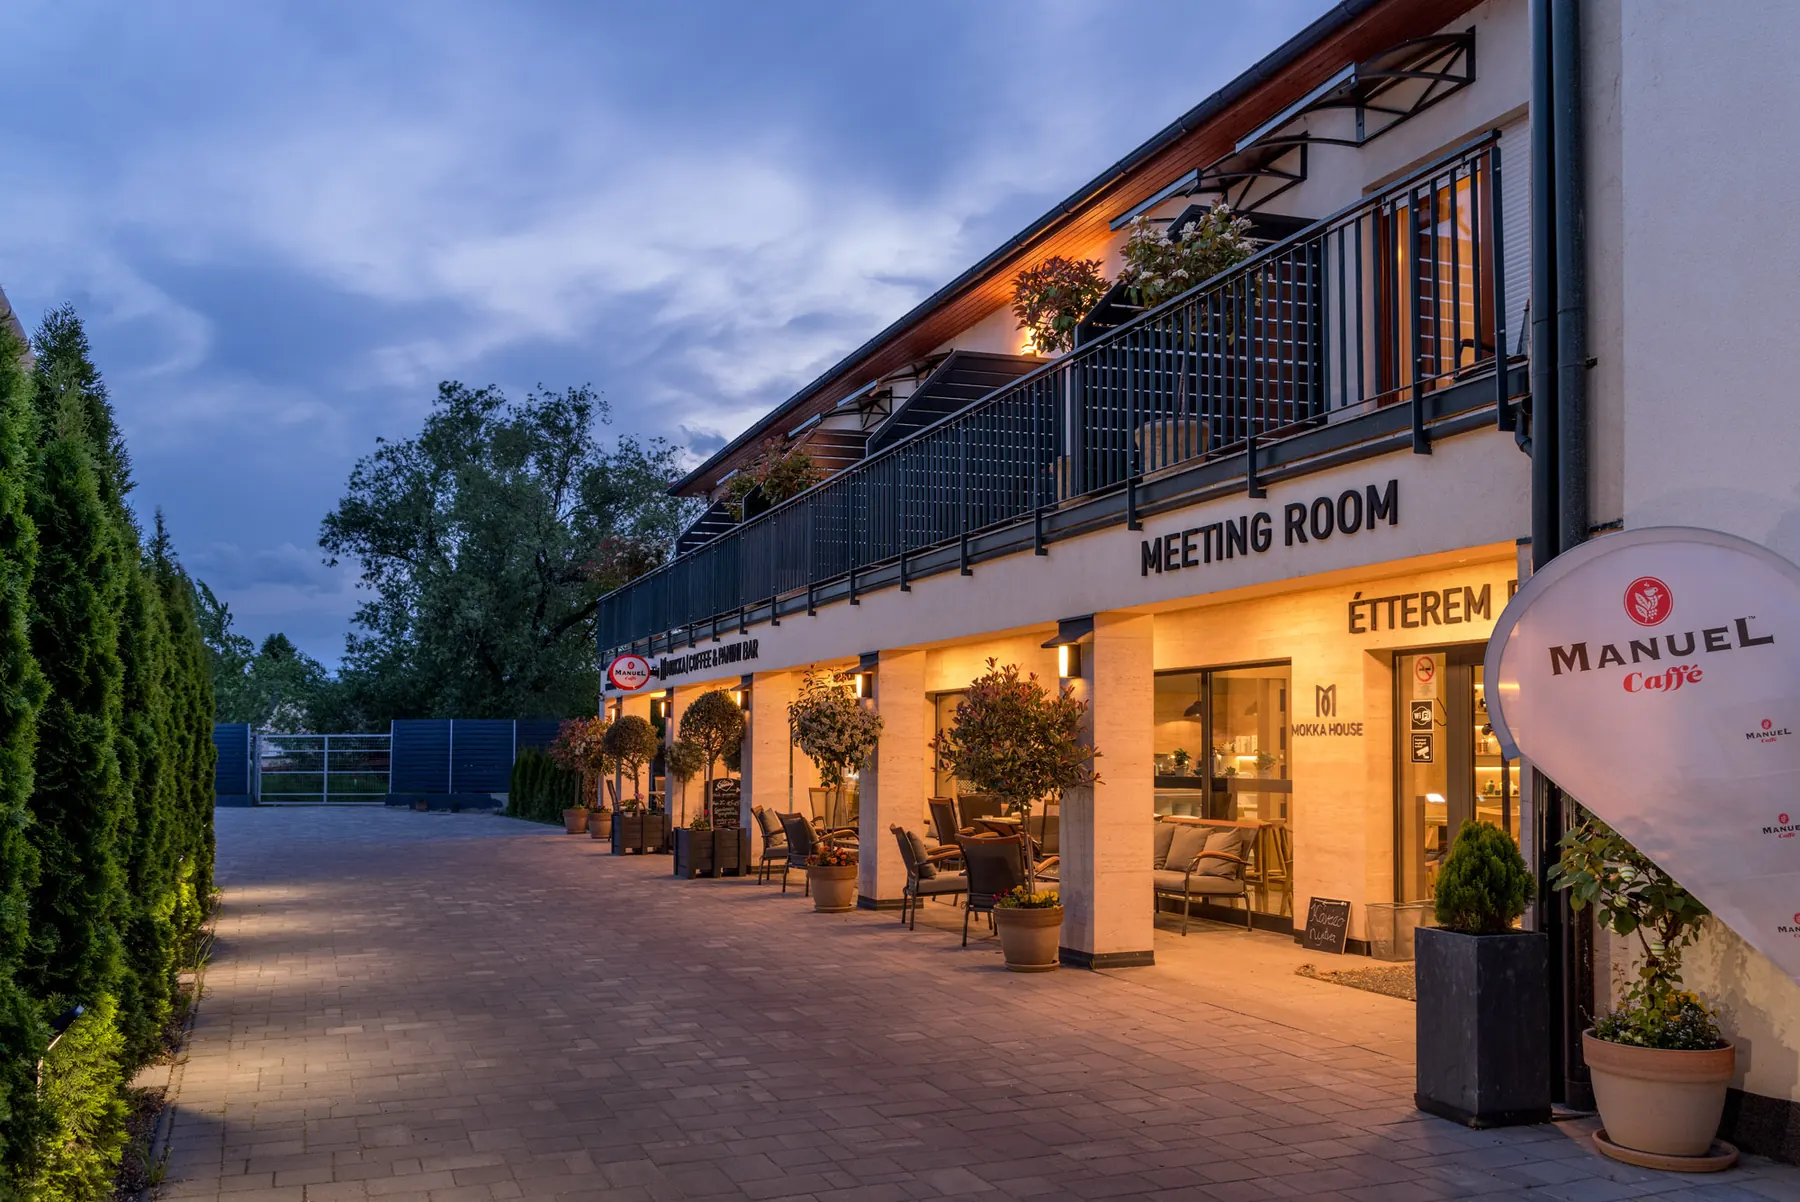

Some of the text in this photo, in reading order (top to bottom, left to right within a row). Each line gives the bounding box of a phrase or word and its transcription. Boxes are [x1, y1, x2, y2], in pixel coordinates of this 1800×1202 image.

[1141, 479, 1399, 577] MEETING ROOM
[1348, 583, 1491, 634] ÉTTEREM
[689, 650, 712, 672] COFFEE
[712, 648, 718, 667] &
[742, 639, 759, 661] BAR
[1548, 616, 1775, 676] MANUEL
[615, 669, 647, 677] MANUEL
[1623, 664, 1704, 693] Caffé
[1291, 722, 1364, 737] MOKKA HOUSE
[1745, 728, 1792, 740] MANUEL
